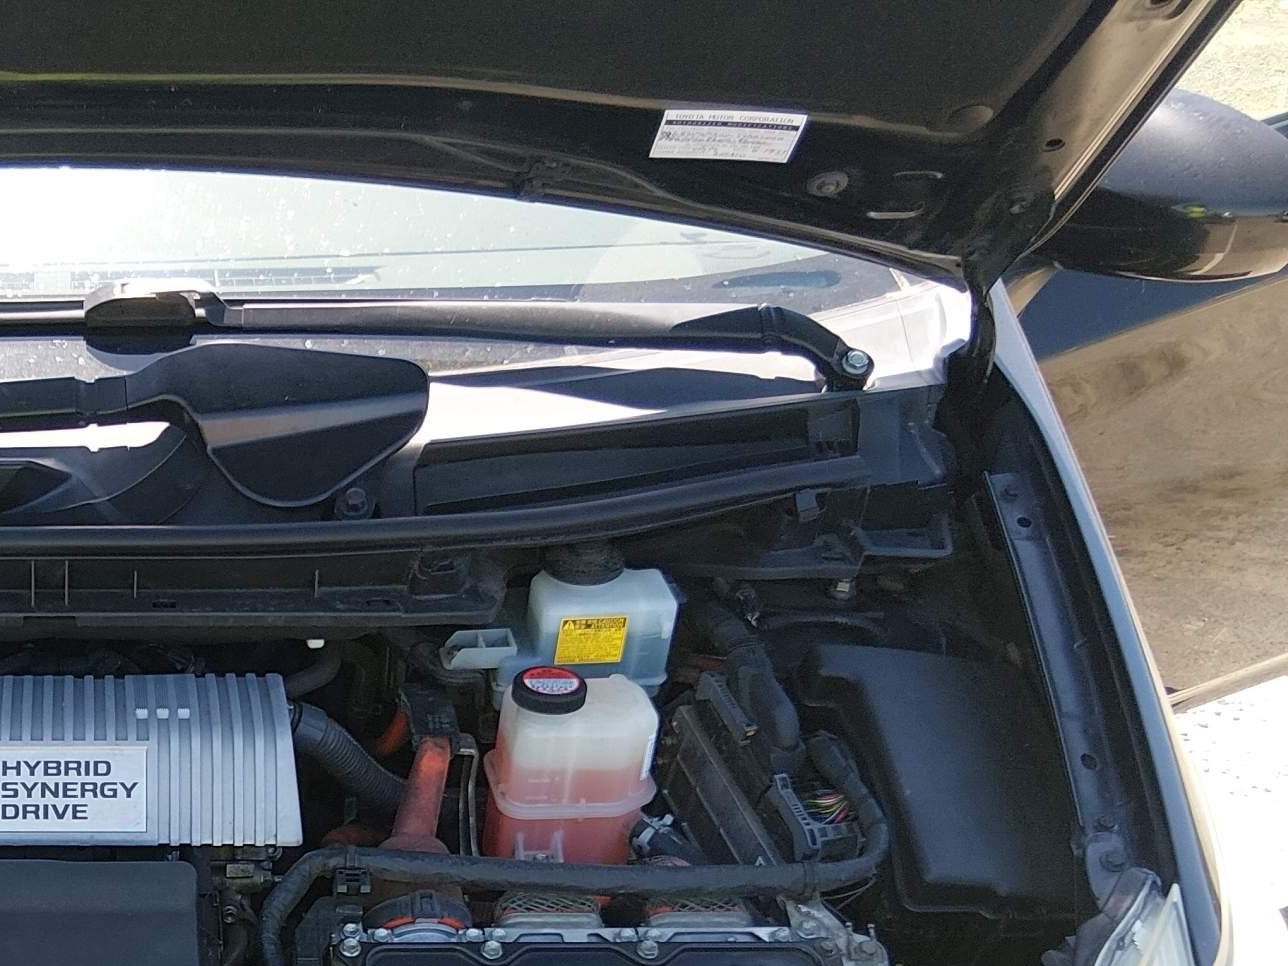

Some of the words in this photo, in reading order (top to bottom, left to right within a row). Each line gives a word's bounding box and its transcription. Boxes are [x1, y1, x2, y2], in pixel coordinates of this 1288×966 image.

[1, 760, 112, 777] HYBRID
[0, 781, 139, 799] SYNERGY
[0, 803, 89, 820] DRIVE
